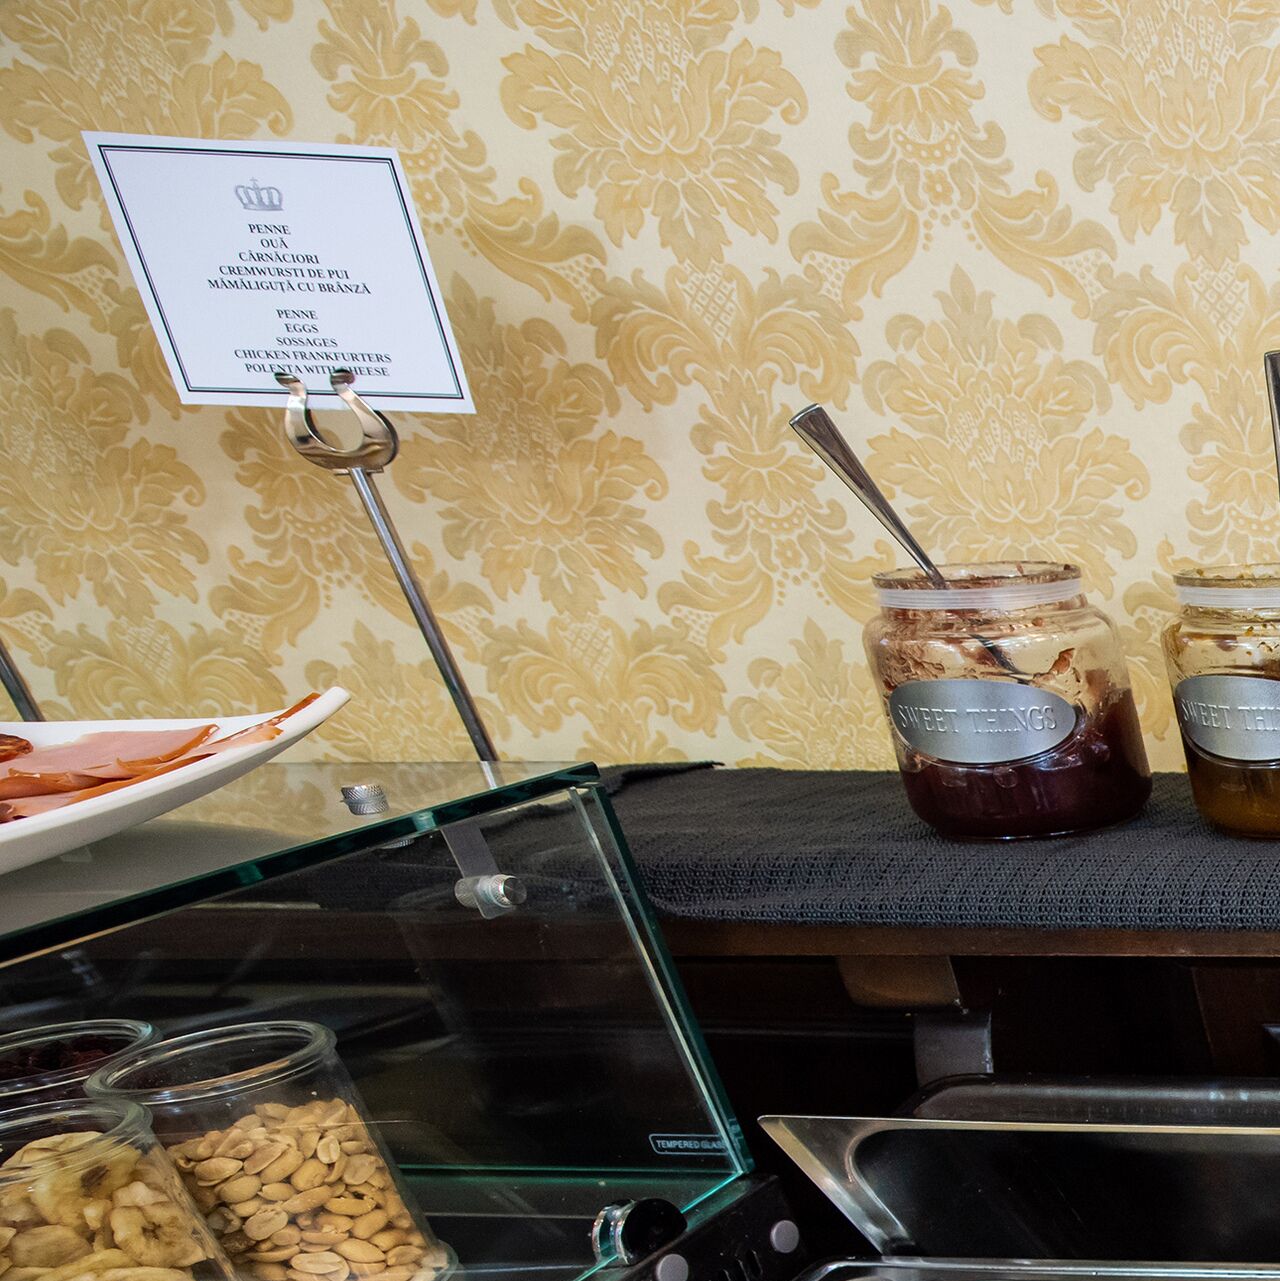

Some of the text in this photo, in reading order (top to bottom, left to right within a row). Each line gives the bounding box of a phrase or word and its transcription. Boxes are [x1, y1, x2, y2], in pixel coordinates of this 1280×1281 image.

[248, 223, 291, 235] PENNE
[260, 237, 289, 249] OUĂ
[219, 265, 350, 280] CREMWURSTI DE PUI
[297, 282, 316, 293] CU
[276, 308, 318, 320] PENNE
[284, 323, 319, 334] EGGS
[275, 336, 338, 348] SOSSAGES
[234, 349, 392, 363] CHICKEN FRANKFURTERS
[245, 363, 390, 377] POLENTA WITH HEESE
[898, 704, 1057, 734] SWEET THINGS
[1181, 699, 1232, 730] SWEET
[656, 1140, 700, 1149] TEMPERED
